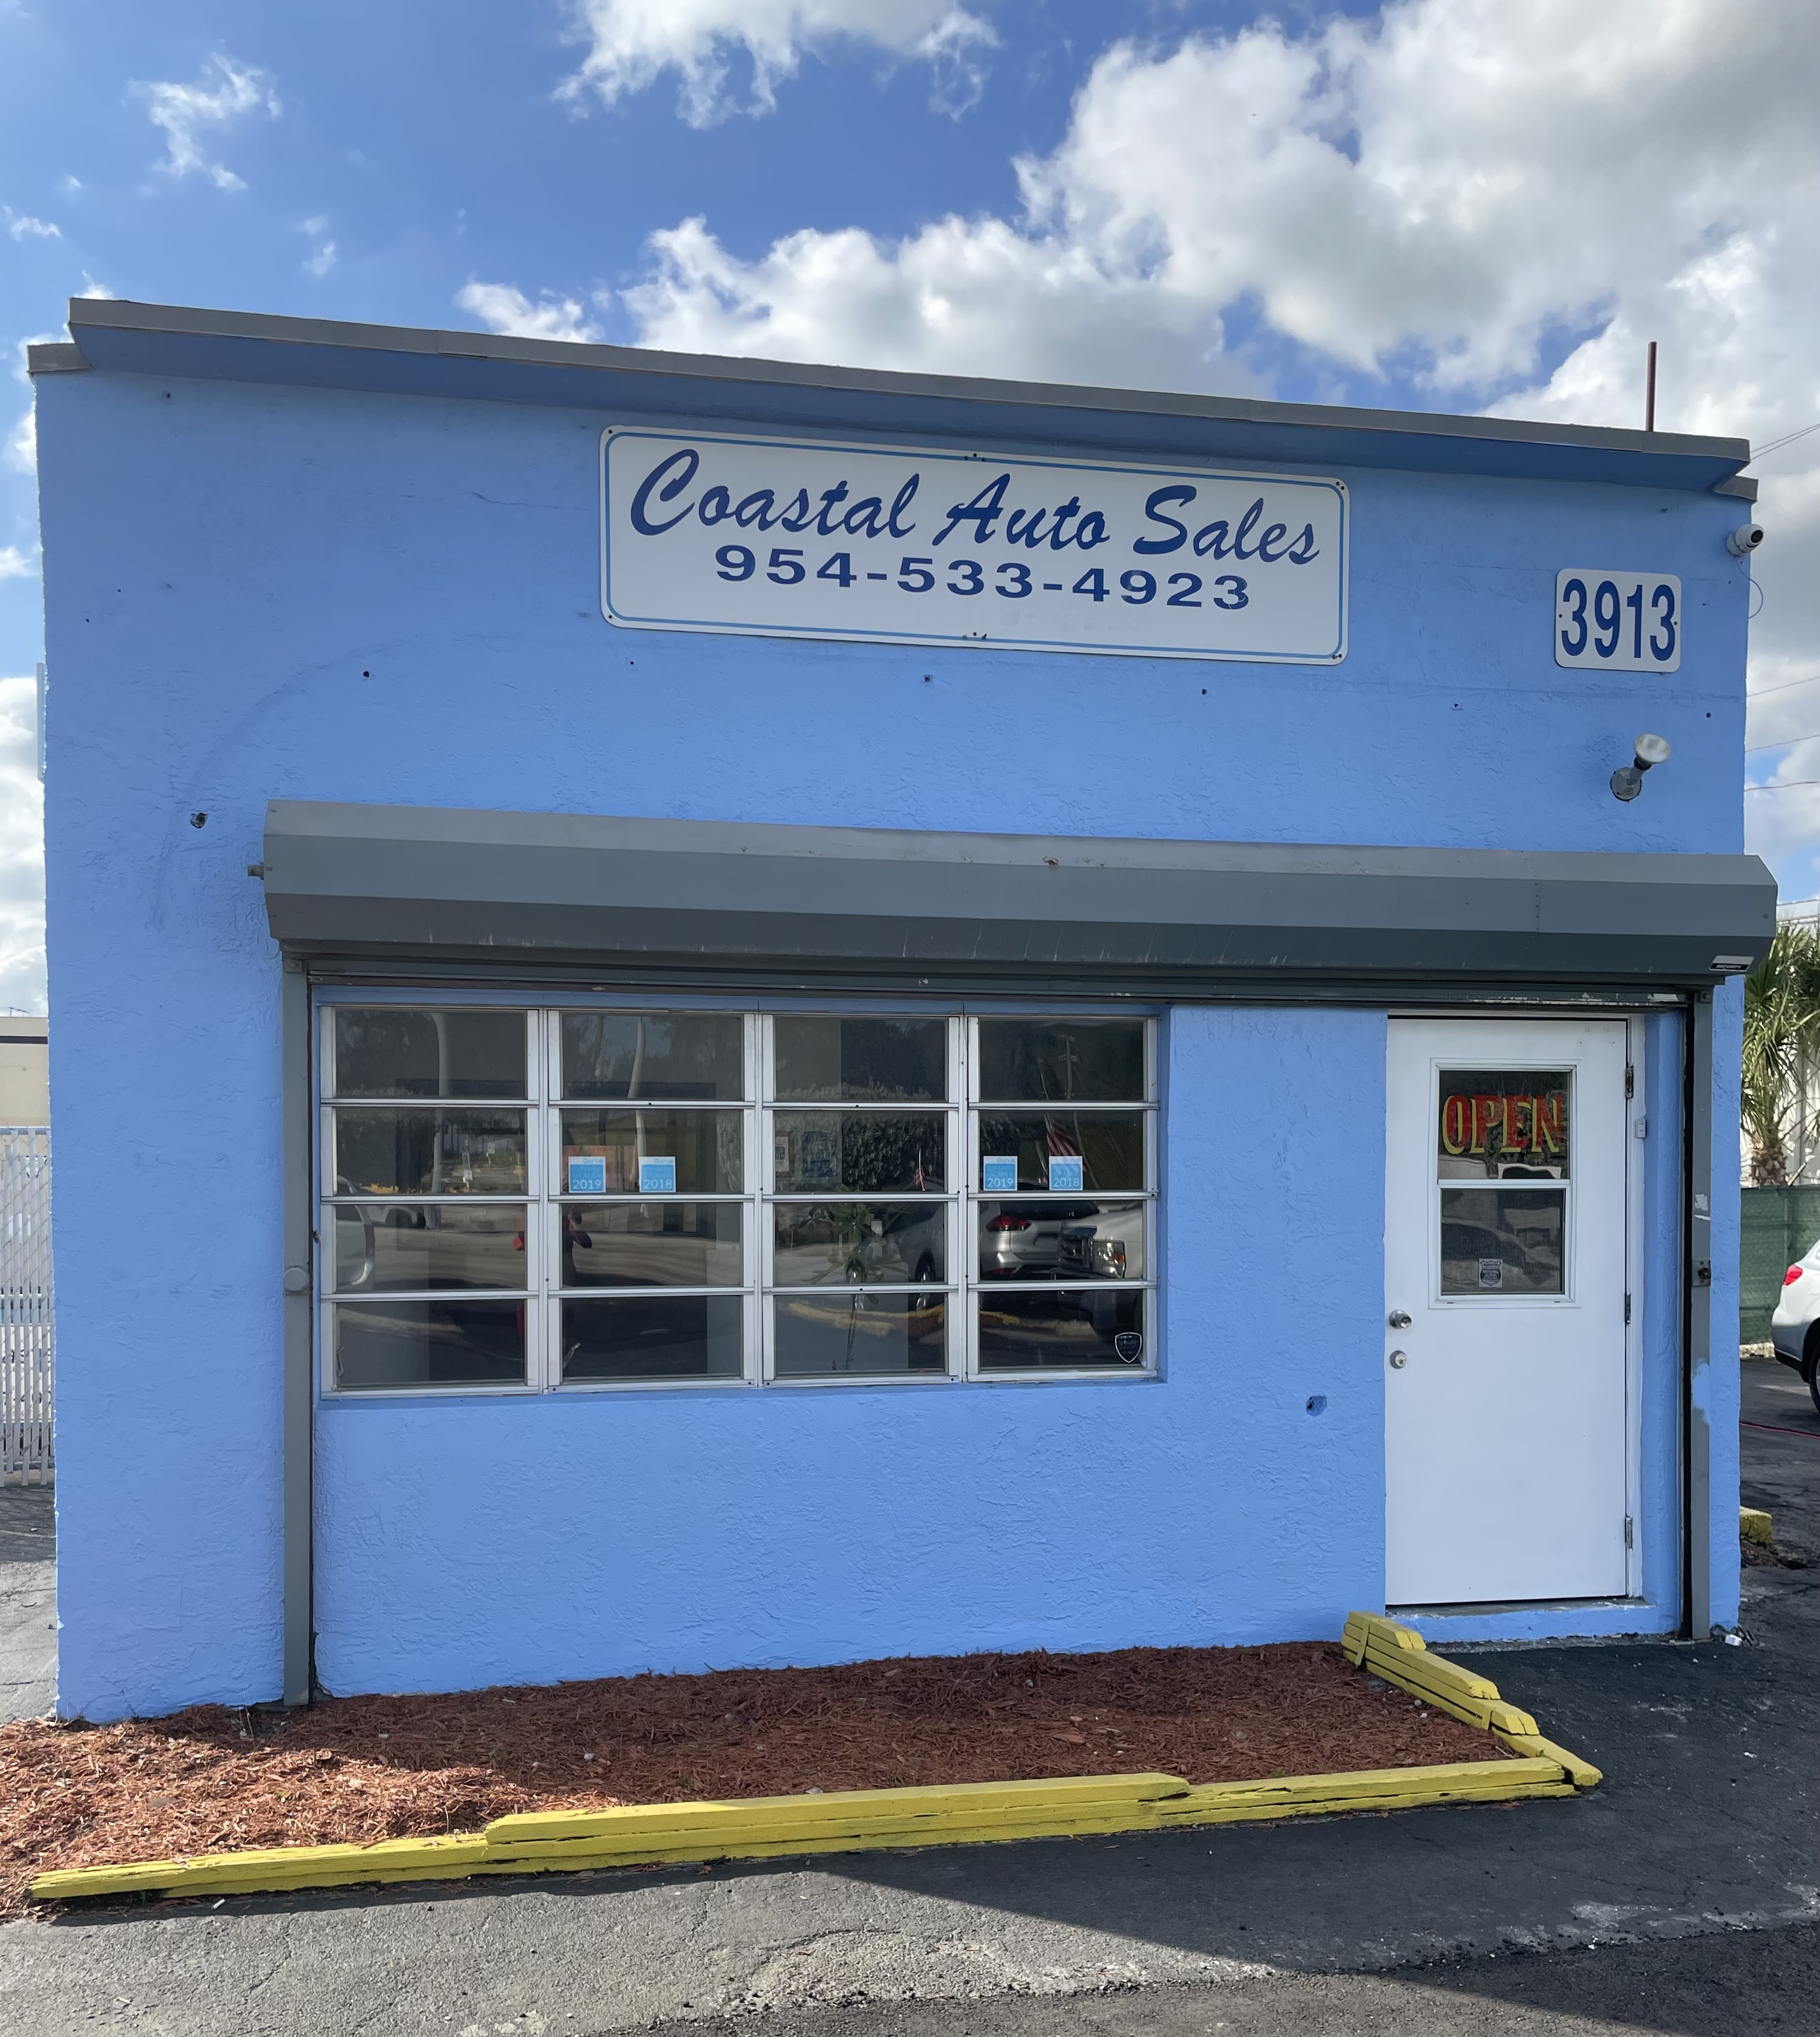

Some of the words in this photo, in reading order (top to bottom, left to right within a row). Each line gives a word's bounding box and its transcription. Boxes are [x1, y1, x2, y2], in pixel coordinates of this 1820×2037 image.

[631, 449, 919, 538] Coastal
[932, 473, 1110, 550] Auto
[1133, 485, 1320, 564] Sales
[715, 545, 1248, 610] 954-533-4923
[1562, 579, 1675, 661] 3913
[1442, 1094, 1564, 1154] OPEN
[573, 1179, 601, 1189] 2019
[644, 1179, 672, 1189] 2018
[987, 1178, 1013, 1187] 2019
[1053, 1178, 1080, 1187] 2018
